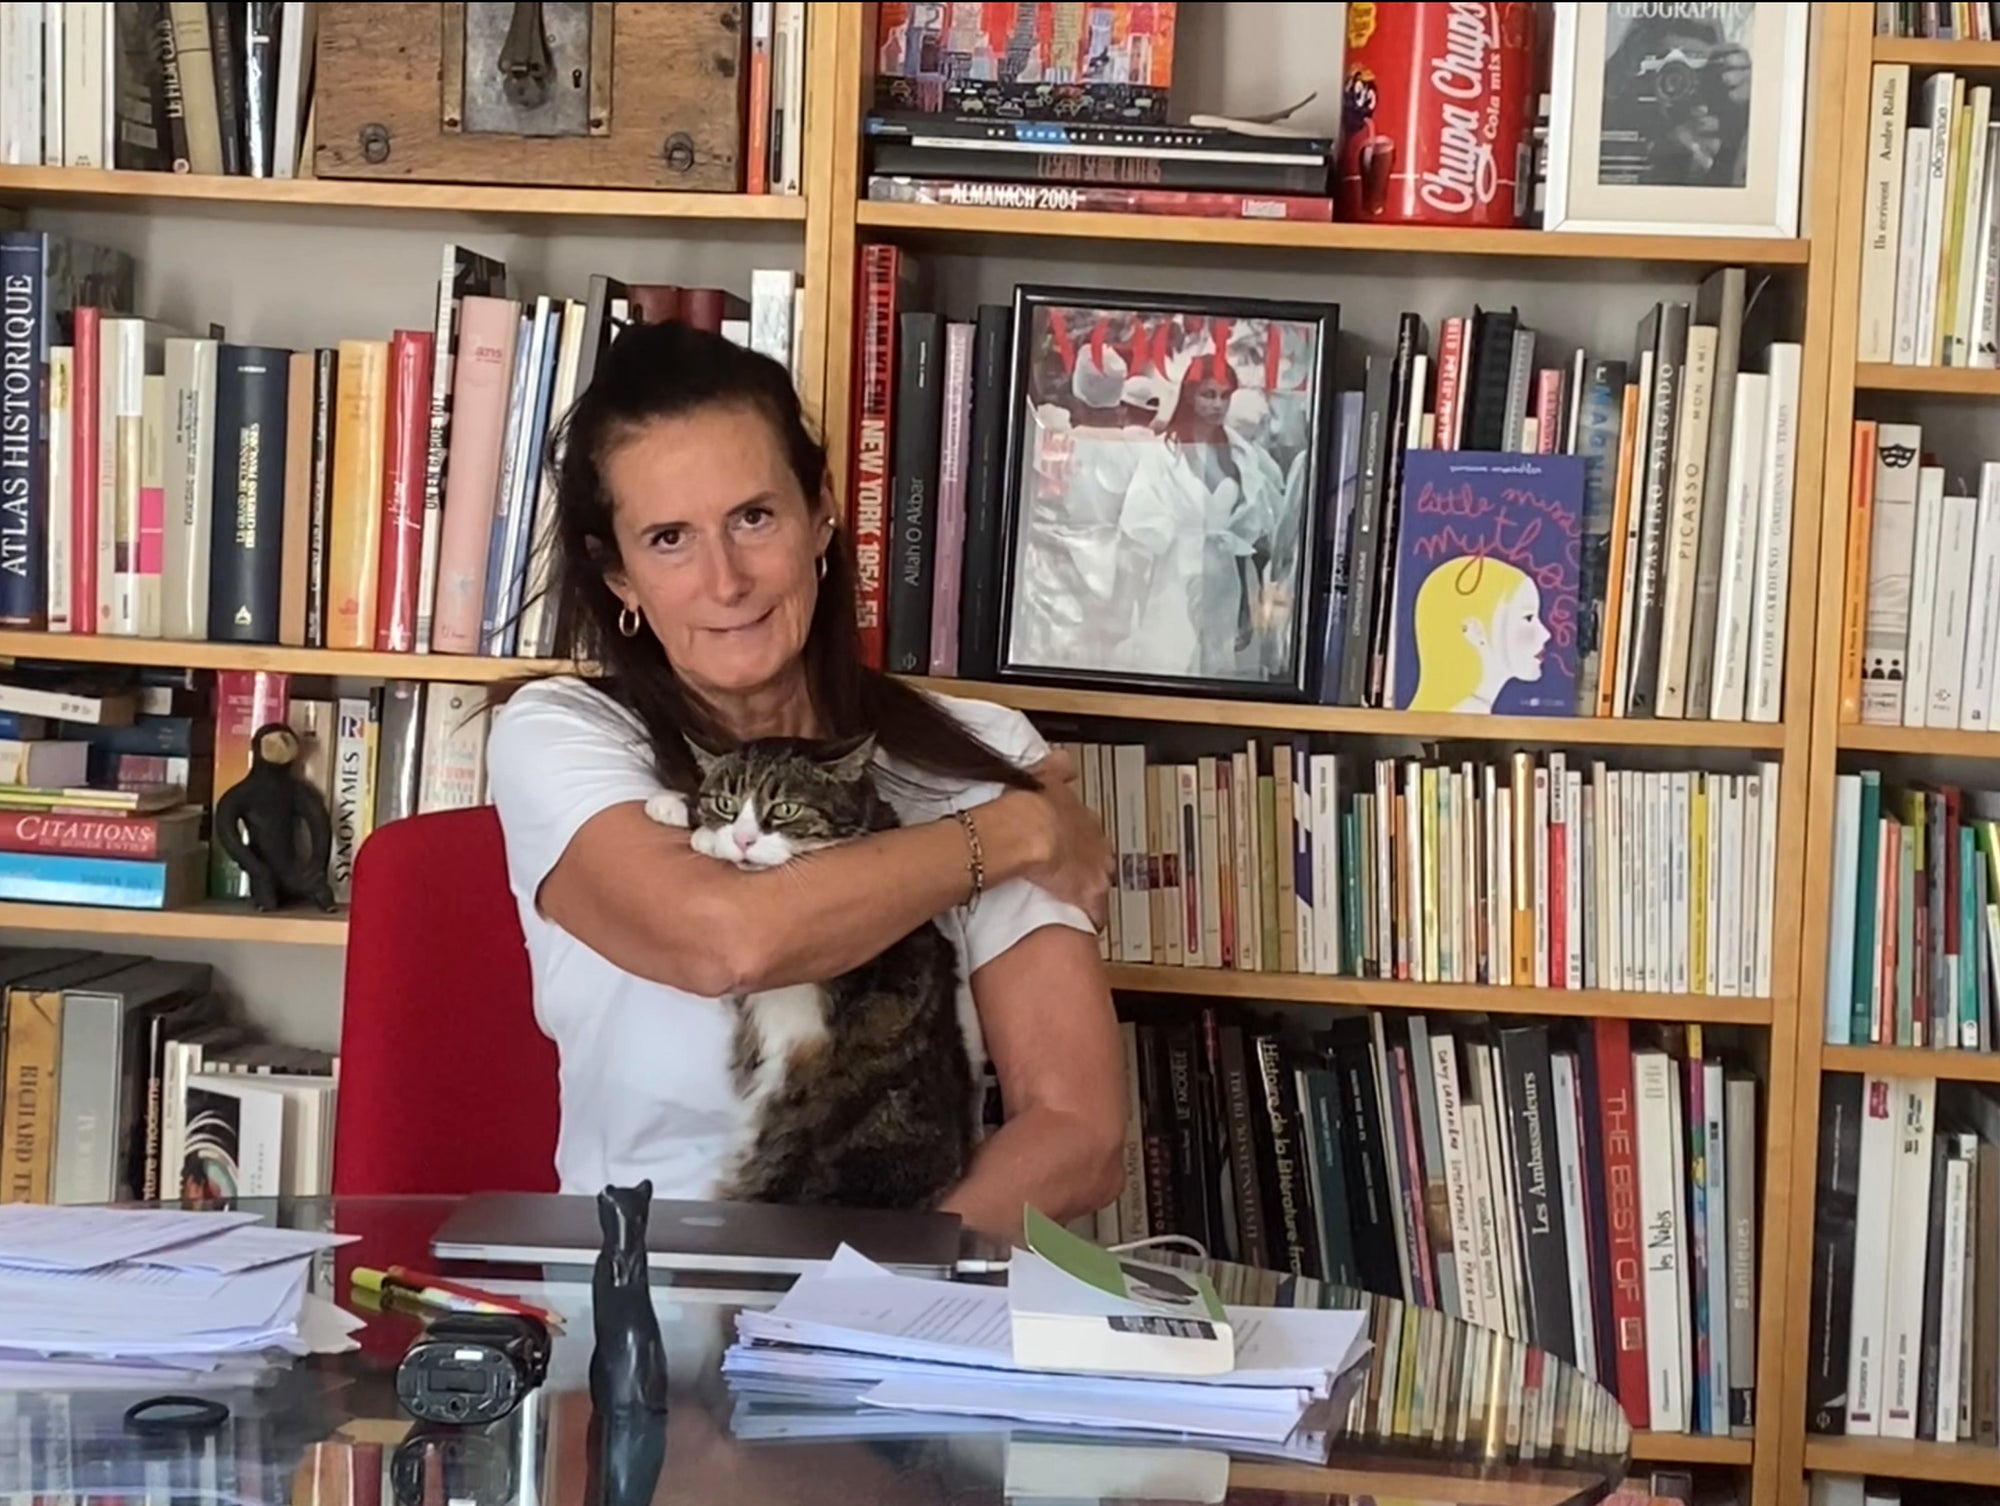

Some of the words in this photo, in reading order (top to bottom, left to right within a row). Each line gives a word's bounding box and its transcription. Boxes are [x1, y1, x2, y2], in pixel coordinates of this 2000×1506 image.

[1617, 3, 1752, 19] GEOGRAPHIC
[1430, 3, 1490, 99] Chups
[1487, 53, 1501, 91] mix
[1483, 96, 1500, 140] Cola
[1420, 102, 1488, 213] Chupa
[951, 183, 1037, 208] ALMANACH
[1039, 188, 1078, 211] 2004
[3, 274, 35, 468] HISTORIQUE
[1047, 307, 1313, 394] VOGUE
[859, 419, 885, 474] NEW
[1652, 363, 1675, 470] SALGADO
[1, 477, 29, 577] ATLAS
[857, 477, 883, 538] YORK
[906, 475, 925, 525] Akbar
[1677, 462, 1700, 559] PICASSO
[903, 544, 922, 587] Allah
[905, 527, 922, 543] O
[1762, 630, 1775, 668] FLOR
[16, 815, 155, 843] CITATIONS
[334, 750, 361, 883] SYNONYMES
[1262, 1043, 1282, 1107] Histoire
[14, 1064, 39, 1163] RICHARD
[144, 1077, 161, 1155] moderne
[1271, 1111, 1288, 1134] de
[1522, 1072, 1547, 1198] Ambassadeurs
[1607, 1088, 1631, 1155] THE
[1275, 1138, 1291, 1155] la
[1477, 1196, 1492, 1257] Bourgeois
[1531, 1203, 1550, 1235] Les
[1610, 1164, 1637, 1251] BEST
[1647, 1210, 1674, 1249] Nabis
[1483, 1260, 1497, 1300] Louise
[1615, 1257, 1640, 1302] OF
[1733, 1218, 1751, 1310] Banlieues
